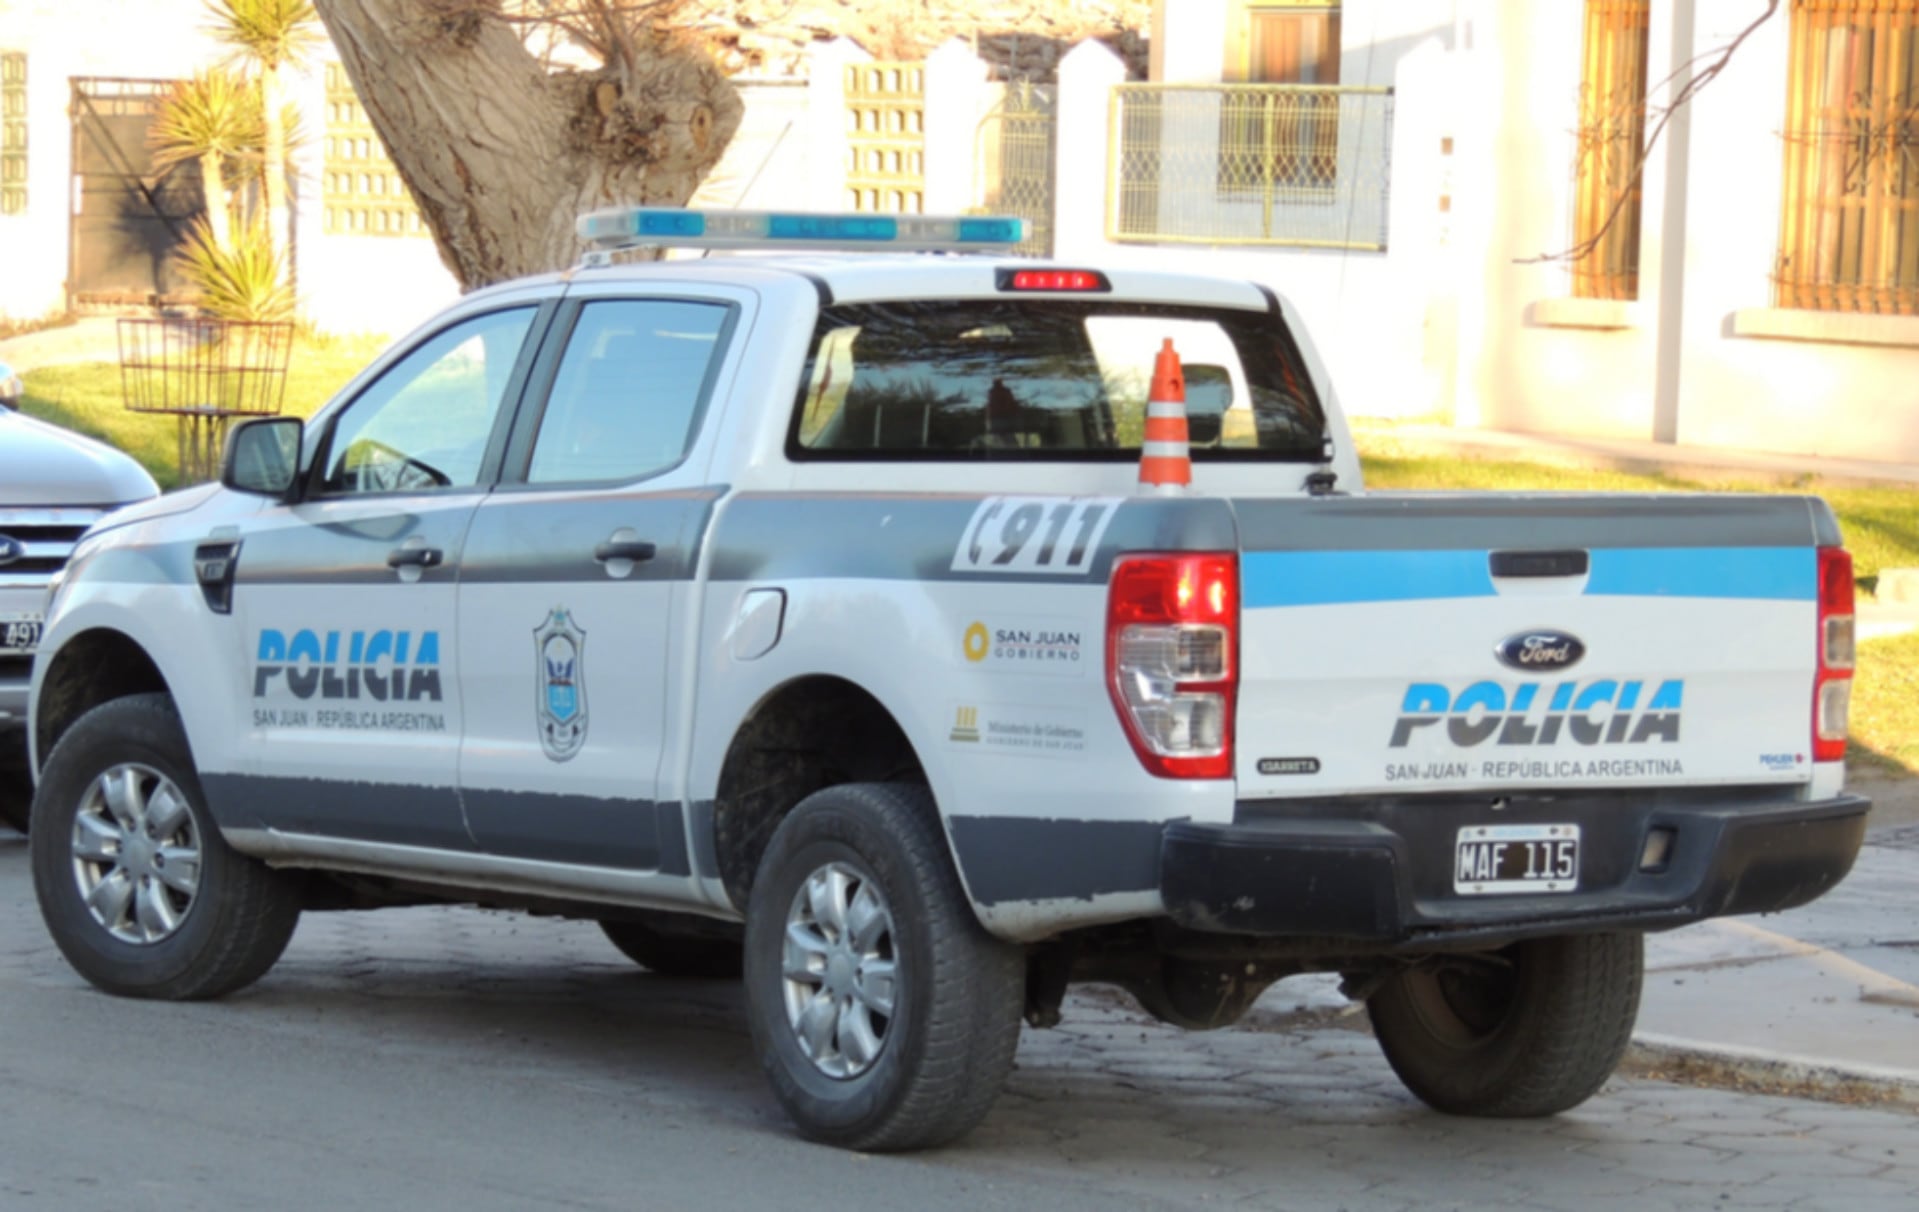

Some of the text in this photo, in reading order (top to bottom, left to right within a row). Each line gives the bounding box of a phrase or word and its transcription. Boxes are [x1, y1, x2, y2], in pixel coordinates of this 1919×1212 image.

[992, 503, 1107, 566] 911
[996, 629, 1080, 645] SAN JUAN
[1519, 635, 1570, 663] Ford
[253, 628, 443, 701] POLICIA
[995, 647, 1080, 661] GOBIERNO
[253, 707, 446, 731] SAN JUAN REPÚBLICA ARGENTINA
[1388, 679, 1684, 747] POLICIA
[1385, 758, 1683, 781] SAN JUAN REPÚBLICA ARGENTINA
[1460, 842, 1574, 881] MAF 115
